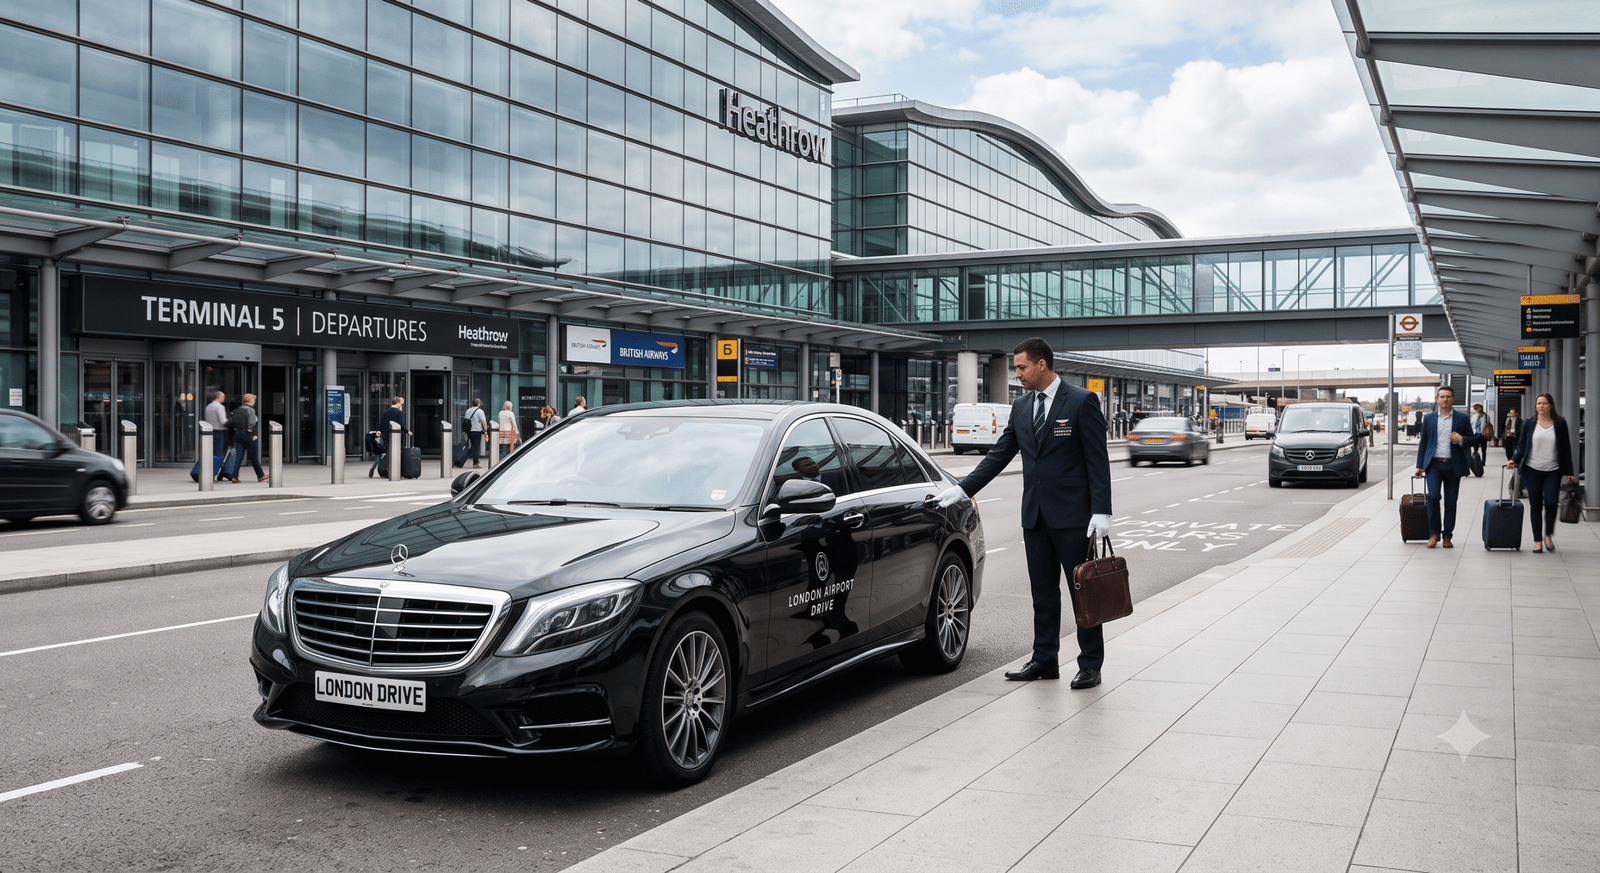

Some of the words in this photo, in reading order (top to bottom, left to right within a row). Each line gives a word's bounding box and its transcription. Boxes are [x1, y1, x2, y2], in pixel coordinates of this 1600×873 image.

[724, 88, 828, 162] Heathrow
[141, 295, 266, 330] TERMINAL
[272, 307, 285, 331] 5
[312, 311, 427, 342] DEPARTURES
[458, 324, 509, 343] Heathrow
[619, 347, 643, 359] BRITISH
[643, 349, 669, 361] AIRWAYS
[1110, 520, 1303, 532] PRIVATE
[1116, 529, 1249, 540] CARS
[1097, 539, 1238, 552] ONLY
[788, 587, 822, 608] LONDON
[823, 578, 855, 597] AIRPORT
[810, 599, 834, 617] DRIVE
[316, 676, 373, 701] LONDON
[377, 684, 424, 706] DRIVE
